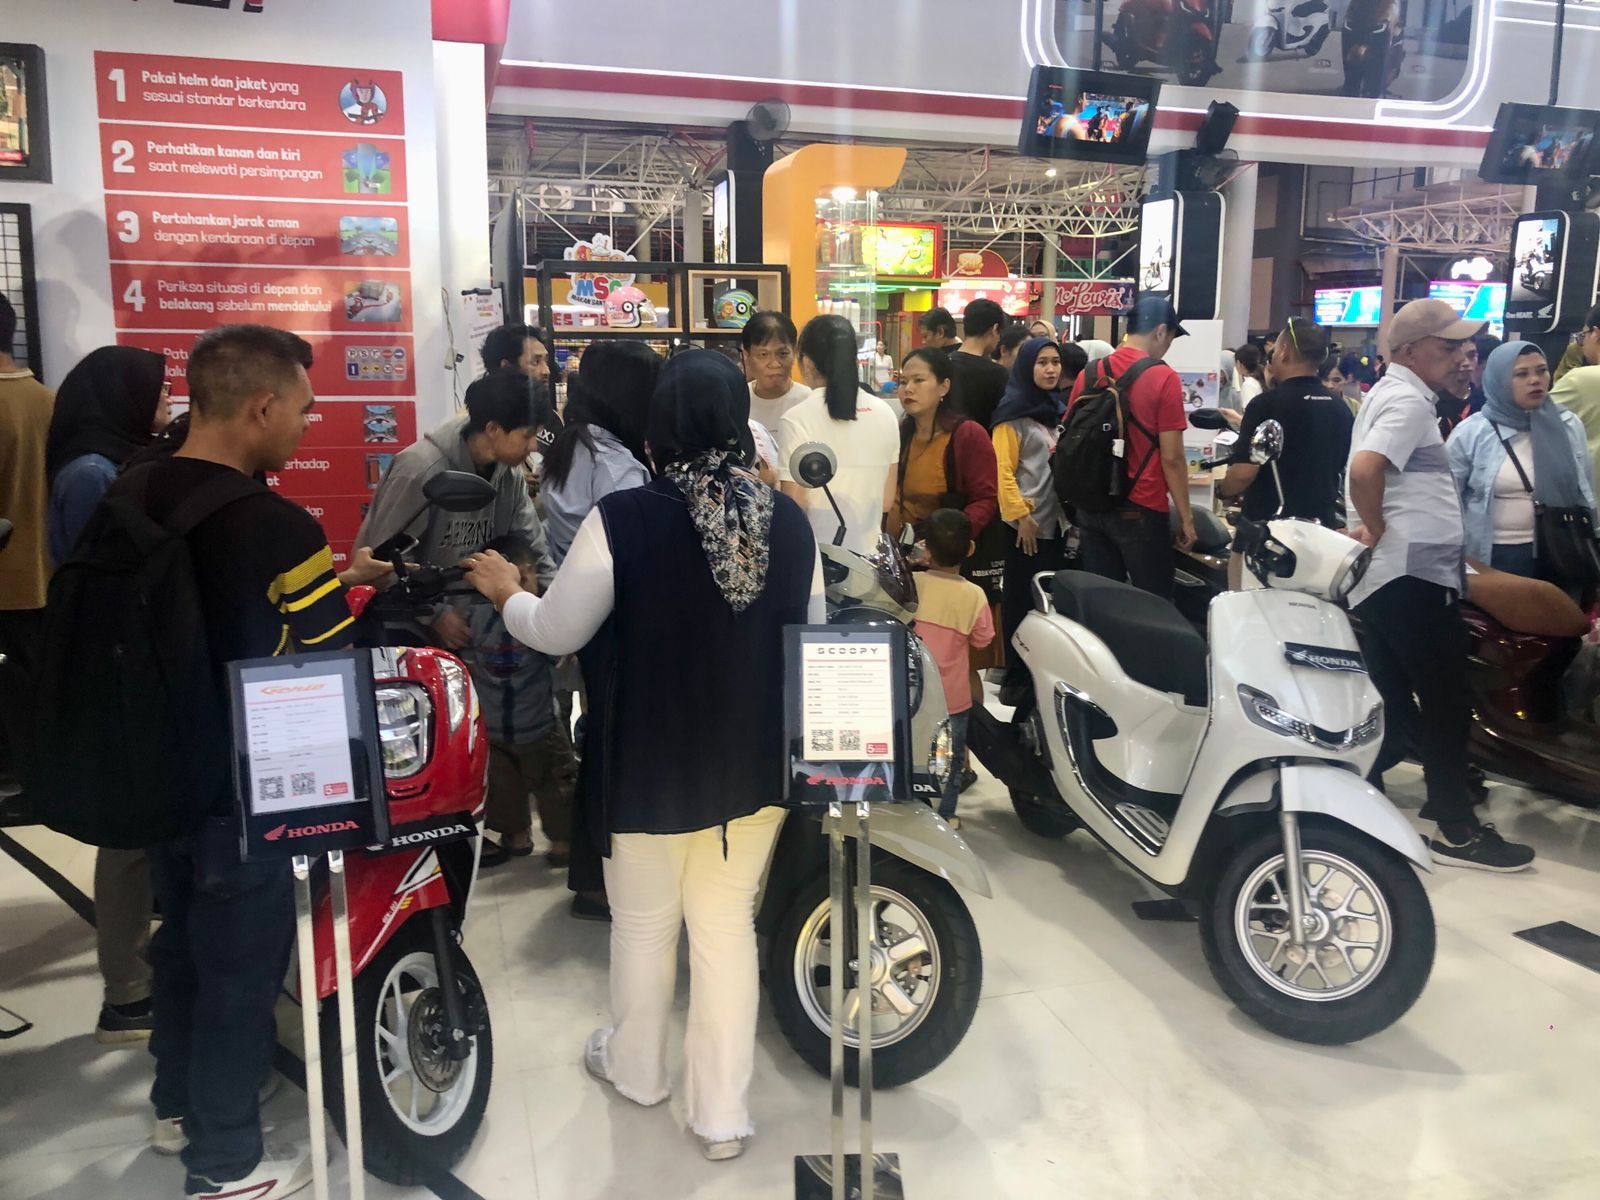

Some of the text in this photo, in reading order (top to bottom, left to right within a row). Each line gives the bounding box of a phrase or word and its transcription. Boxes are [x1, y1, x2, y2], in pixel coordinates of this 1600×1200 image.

[108, 68, 126, 102] 1
[141, 70, 299, 95] Pakai helm dan jaket yang
[143, 91, 306, 111] sesuai standar berkendara
[111, 139, 136, 173] 2
[146, 141, 301, 161] Perhatikan kanan dan kiri
[148, 161, 323, 181] saat melewati persimpangan
[116, 210, 140, 244] 3
[152, 211, 300, 229] Pertahankan jarak aman
[154, 230, 315, 248] dengan kendaraan di depan
[123, 280, 146, 312] 4
[158, 280, 321, 297] Periksa situasi di depan dan
[159, 298, 332, 313] belakang sebelum mendahului
[284, 458, 330, 472] erhadap
[817, 647, 878, 655] SCOOPY
[1308, 654, 1362, 669] HONDA
[867, 743, 875, 754] 5
[826, 776, 886, 785] HONDA
[287, 820, 360, 839] HONDA
[391, 823, 471, 847] HONDA
